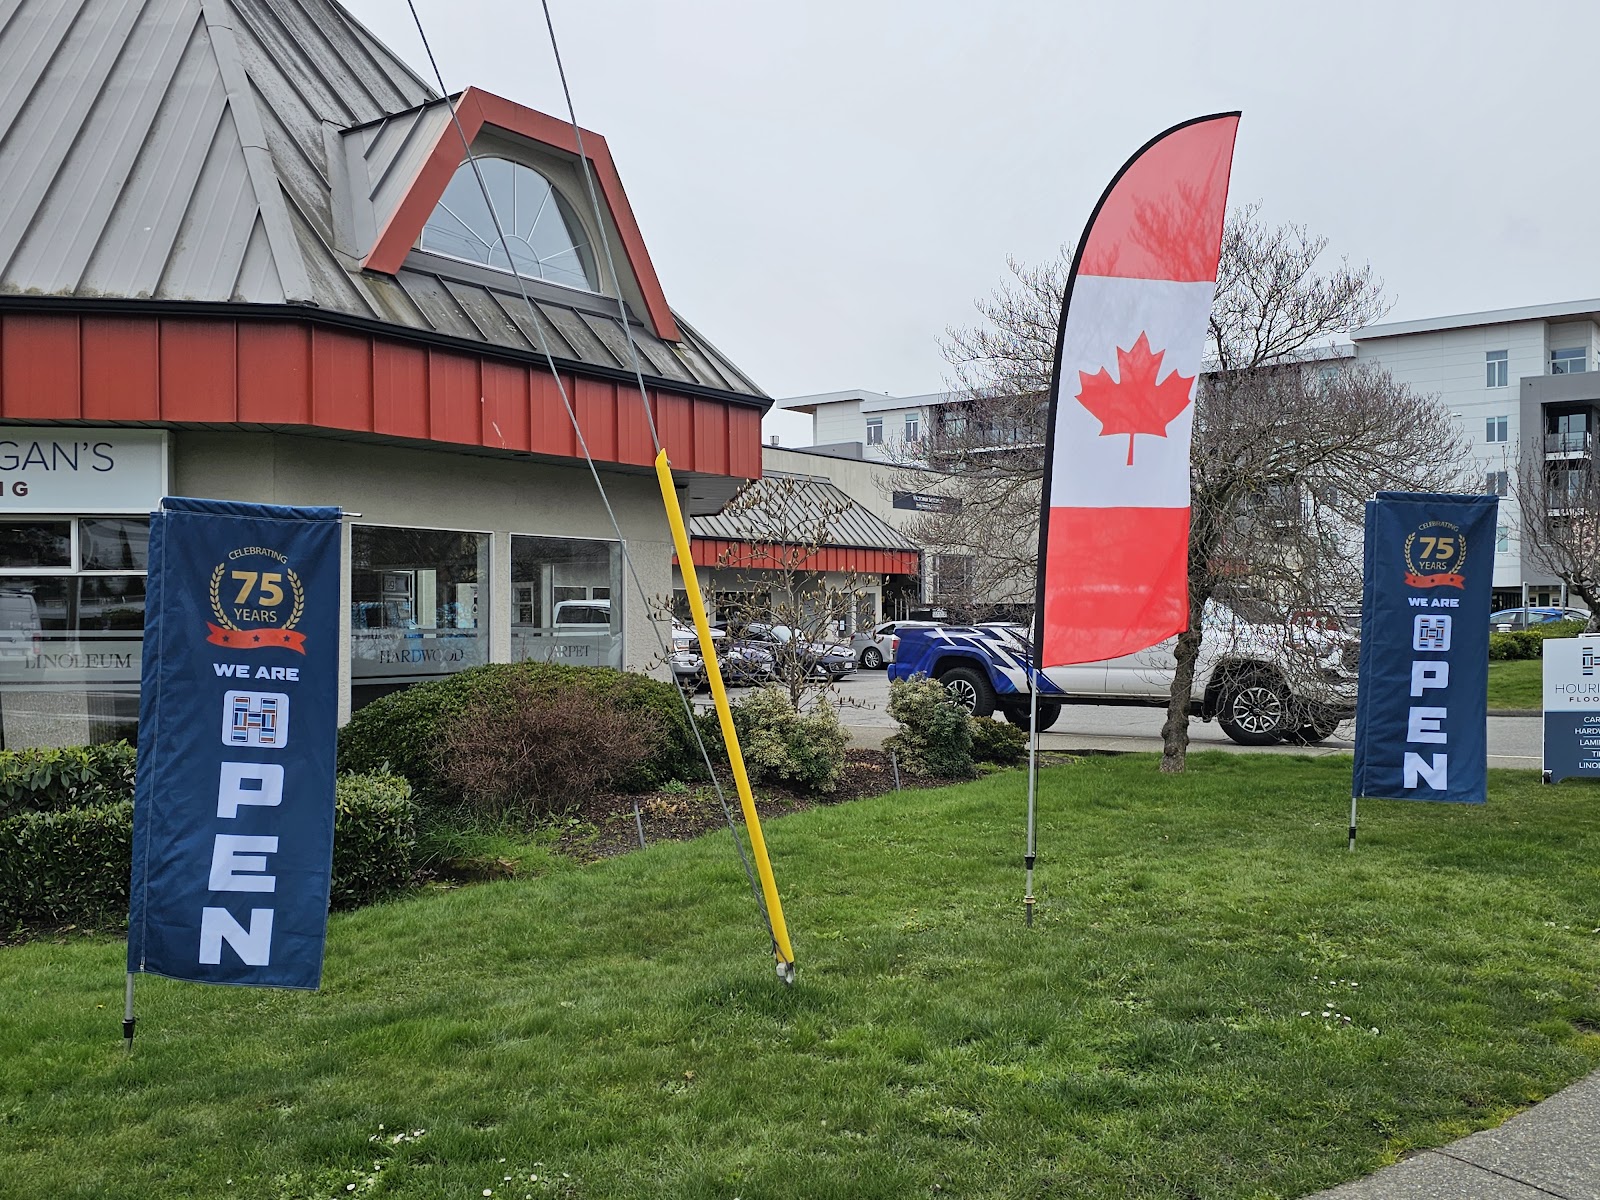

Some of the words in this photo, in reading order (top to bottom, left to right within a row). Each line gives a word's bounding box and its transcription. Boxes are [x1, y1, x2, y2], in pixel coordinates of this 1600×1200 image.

[0, 441, 114, 472] GAN'S
[1418, 521, 1460, 532] CELEBRATING
[228, 546, 288, 565] CELEBRATING
[1419, 537, 1454, 559] 75
[1419, 561, 1447, 571] YEARS
[231, 570, 284, 607] 75
[1408, 597, 1429, 608] WE
[1430, 598, 1460, 608] ARE
[233, 607, 278, 623] YEARS
[379, 648, 465, 664] HARDWOOD
[543, 645, 590, 658] CARPET
[24, 653, 132, 669] LINOLEUM
[212, 662, 250, 679] WE
[254, 665, 300, 682] ARE
[1574, 727, 1600, 735] HARD
